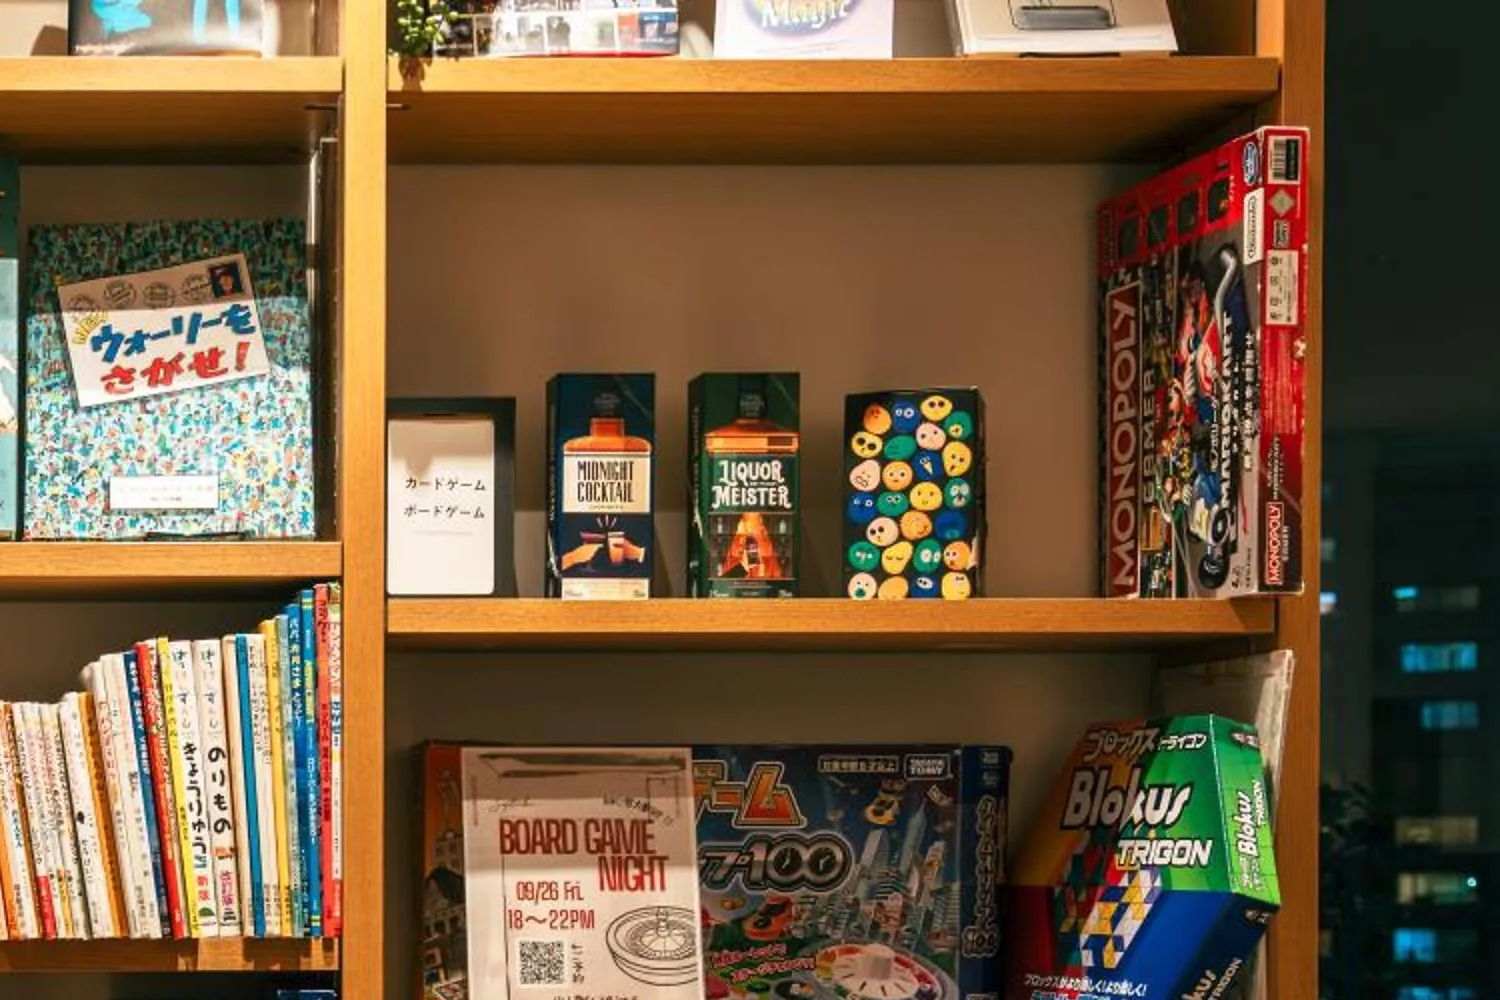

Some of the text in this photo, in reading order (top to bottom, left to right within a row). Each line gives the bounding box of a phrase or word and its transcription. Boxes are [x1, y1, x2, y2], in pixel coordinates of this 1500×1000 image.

[90, 303, 257, 363] ウォーリーを
[1112, 299, 1137, 588] MONOPOLY
[1142, 367, 1157, 505] GAMER
[405, 476, 486, 491] カードゲーム
[577, 460, 635, 481] MIDNIGHT
[718, 460, 786, 484] LIQUOR
[577, 481, 634, 502] COCKTAIL
[711, 485, 793, 509] MEISTER
[403, 504, 485, 519] ボードゲーム
[1268, 503, 1281, 585] MONOPOLY
[1083, 727, 1160, 762] ブロックス
[206, 747, 233, 835] のりもの
[1062, 767, 1192, 831] Blokus
[499, 818, 655, 855] BOARD GAME
[1235, 791, 1258, 859] Blokus
[1115, 839, 1213, 867] TRIGON
[515, 881, 559, 901] 09/26
[599, 856, 669, 892] NIGHT
